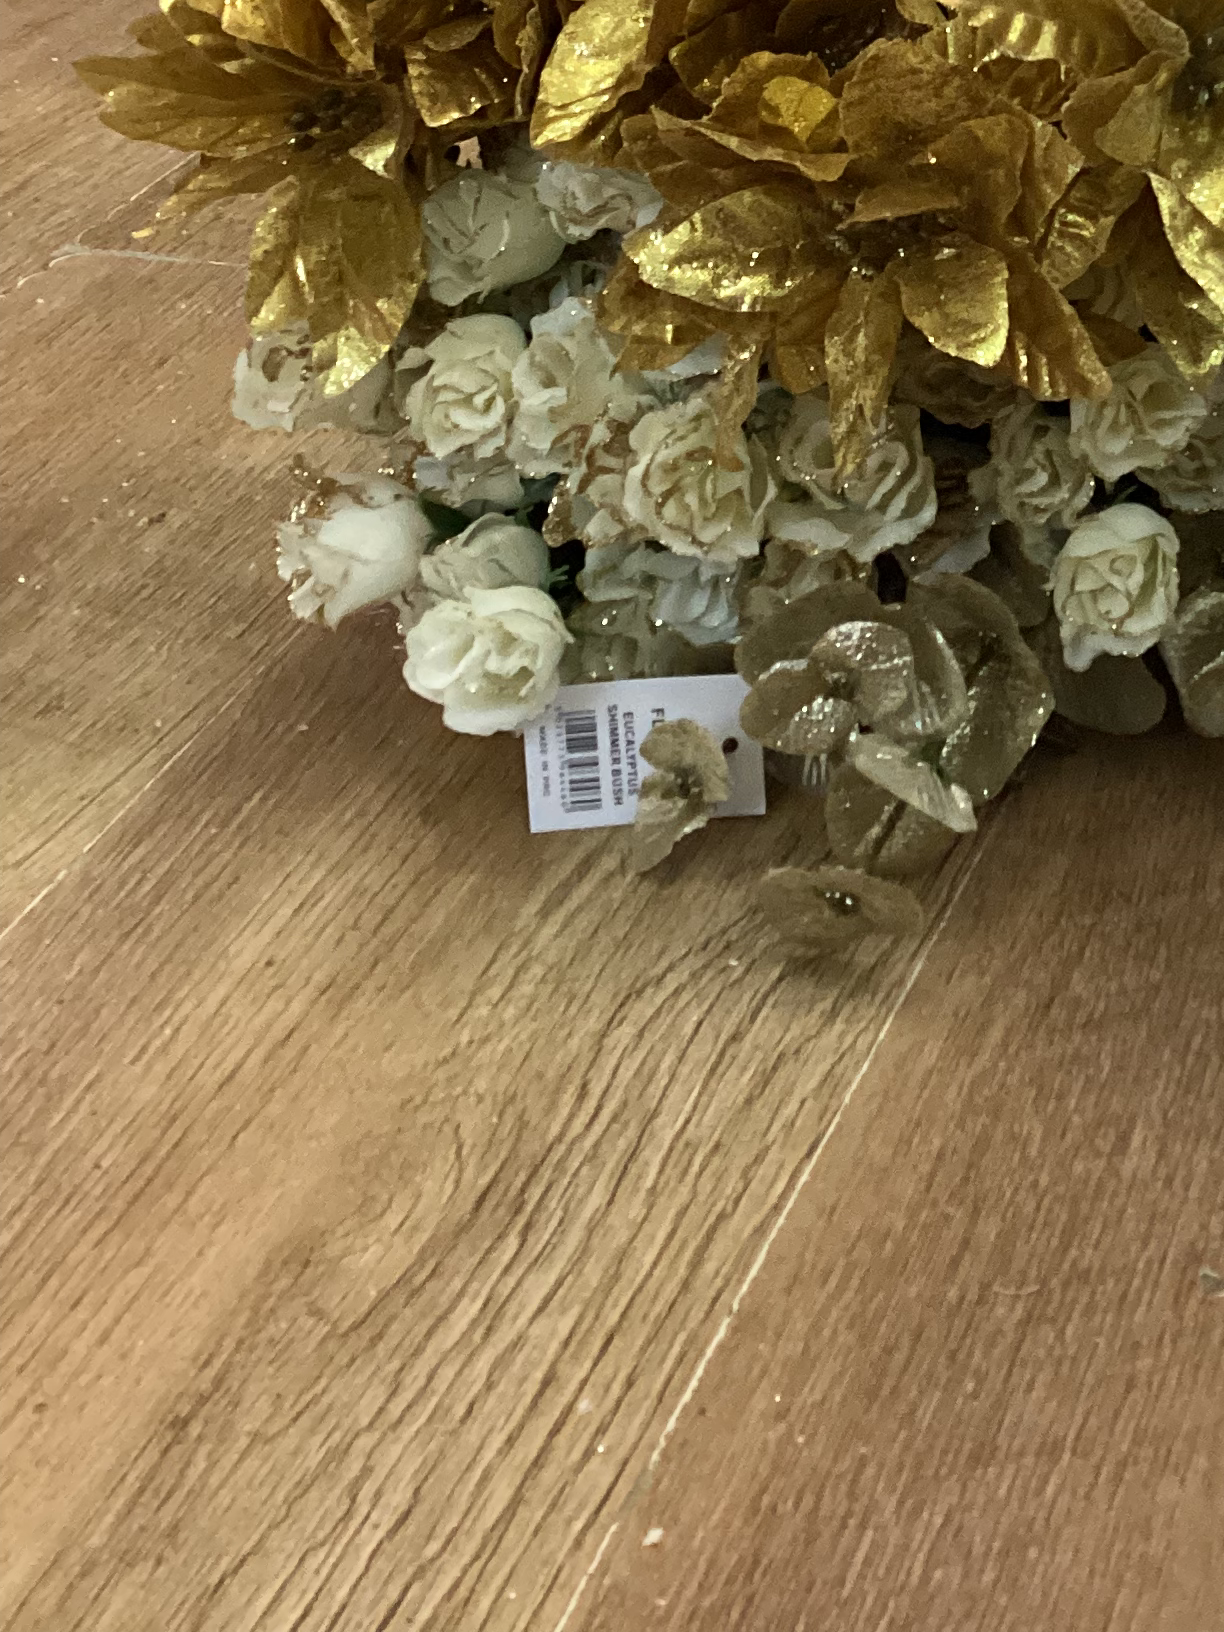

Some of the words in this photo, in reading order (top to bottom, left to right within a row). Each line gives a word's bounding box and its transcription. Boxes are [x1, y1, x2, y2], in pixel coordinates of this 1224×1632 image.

[607, 703, 622, 766] SHIMMER
[622, 711, 639, 797] EUCALYPTUS
[611, 768, 624, 807] BUSH
